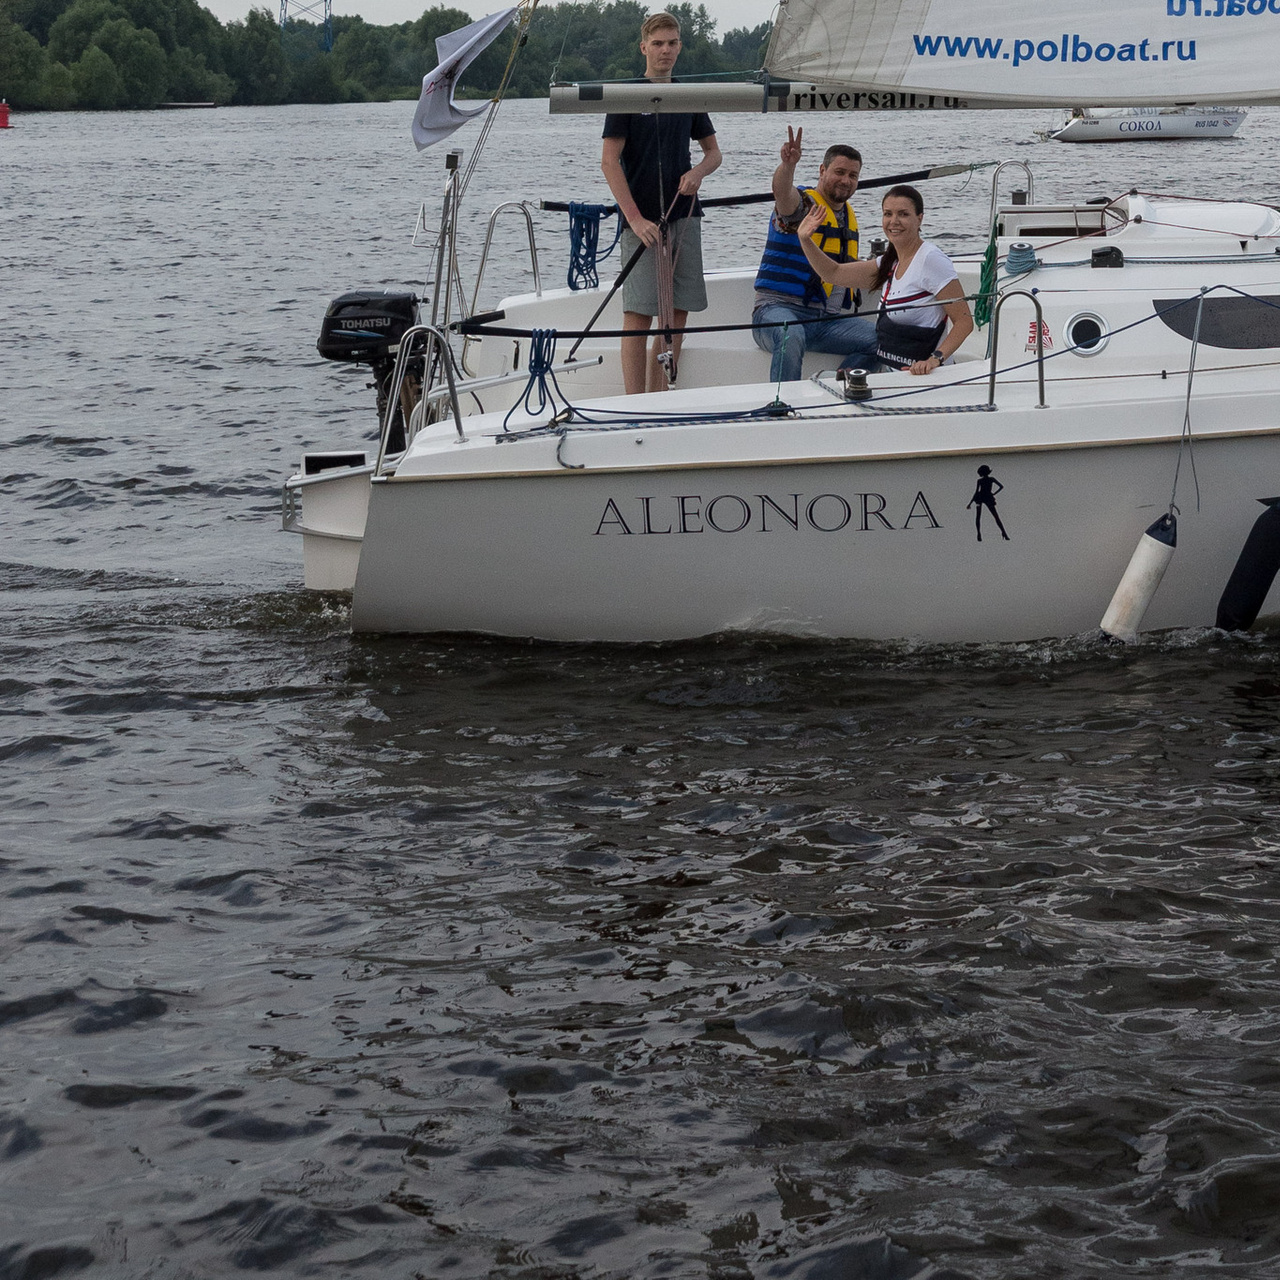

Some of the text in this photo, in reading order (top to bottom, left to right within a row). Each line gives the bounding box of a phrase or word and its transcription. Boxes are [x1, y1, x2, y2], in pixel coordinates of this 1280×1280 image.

[912, 33, 1197, 67] www.polboat.ru
[1119, 120, 1162, 133] СОКОЛ
[340, 318, 391, 329] TOHATSU
[592, 490, 945, 535] ALEONORA
